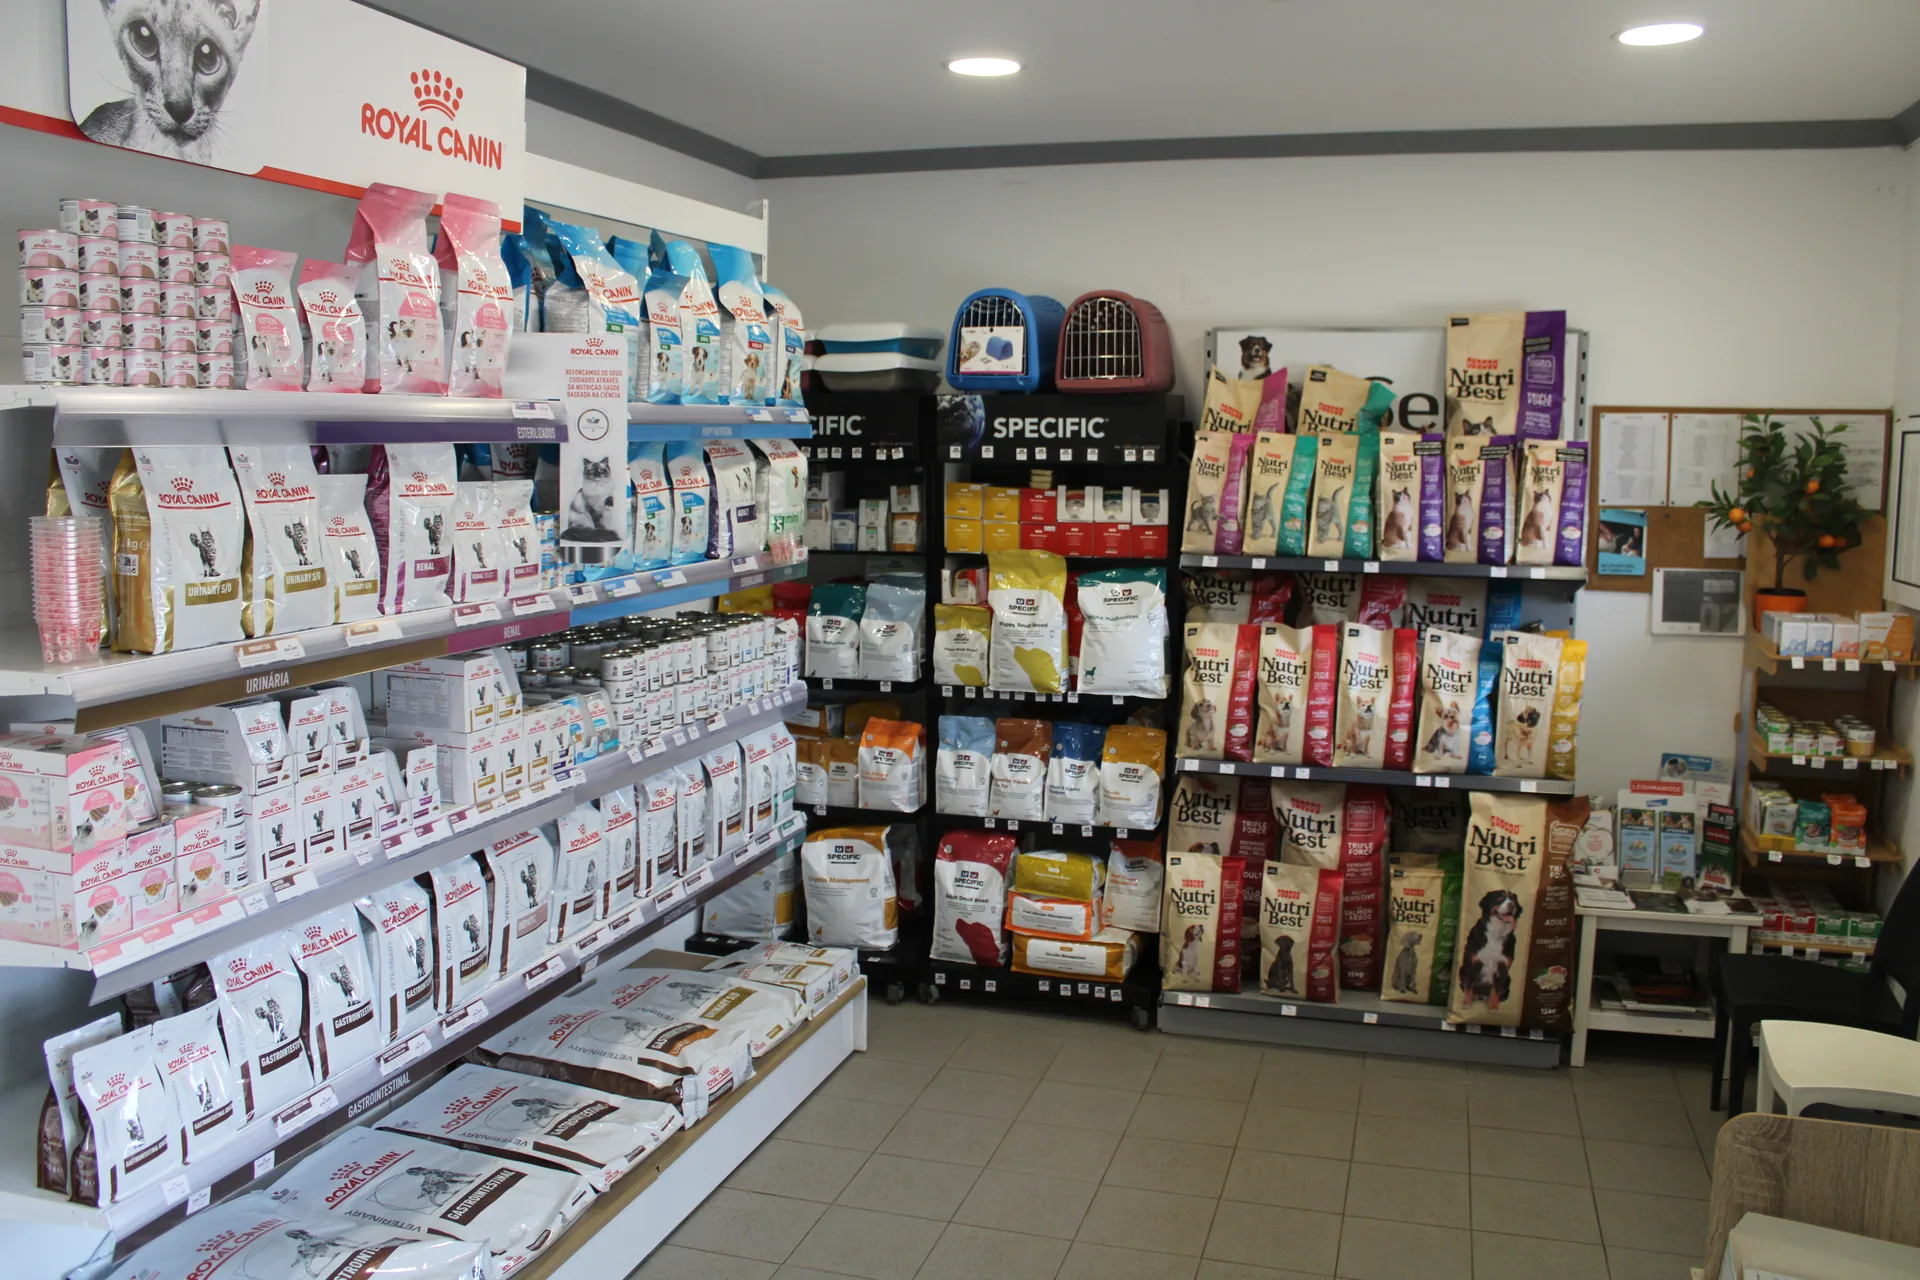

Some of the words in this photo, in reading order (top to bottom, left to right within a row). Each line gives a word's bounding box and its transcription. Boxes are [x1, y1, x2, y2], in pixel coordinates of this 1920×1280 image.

[362, 102, 434, 151] ROYAL
[437, 128, 502, 170] CANIN
[263, 295, 285, 305] CANIN
[603, 286, 632, 299] CANIN
[258, 317, 277, 326] KITTEN
[1450, 368, 1515, 388] Nutri
[1456, 384, 1507, 400] Best
[1527, 392, 1553, 400] TRIPLE
[993, 417, 1105, 438] SPECIFIC
[1204, 408, 1252, 433] Nutri
[1302, 409, 1356, 433] Nutri
[517, 426, 555, 439] ESTERILIZADOS
[1196, 458, 1225, 472] Nutri
[1257, 457, 1288, 469] Nutri
[1260, 465, 1284, 476] Best
[1321, 459, 1352, 473] Nutri
[1385, 461, 1418, 472] Nutri
[1450, 465, 1481, 476] Nutri
[1198, 467, 1221, 479] Best
[1323, 467, 1348, 479] Best
[1389, 470, 1414, 480] Best
[1453, 472, 1477, 483] Best
[1531, 466, 1560, 476] Nutri
[256, 488, 279, 499] ROYAL
[281, 485, 310, 498] CANIN
[405, 483, 425, 493] ROYAL
[426, 483, 447, 493] CANIN
[159, 493, 184, 505] ROYAL
[186, 493, 220, 504] CANIN
[738, 508, 749, 516] ADULT
[416, 562, 435, 571] RENAL
[286, 574, 311, 584] URINARY
[188, 585, 220, 597] URINARY
[1103, 595, 1139, 603] SPECIFIC
[1008, 604, 1039, 612] SPECIFIC
[1409, 603, 1477, 628] Nutri
[504, 627, 521, 638] RENAL
[1262, 657, 1307, 675] Nutri
[1344, 659, 1388, 679] Nutri
[1427, 664, 1472, 683] Nutri
[246, 671, 289, 694] URINÁRIA
[1267, 670, 1301, 686] Best
[1348, 675, 1382, 689] Best
[1504, 667, 1553, 685] Nutri
[1432, 677, 1466, 693] Best
[1508, 682, 1545, 697] Best
[76, 781, 96, 791] ROYAL
[99, 772, 119, 784] CANIN
[91, 792, 108, 801] KITTEN
[1174, 788, 1232, 811] Nutri
[1177, 806, 1222, 825] Best
[1276, 807, 1336, 834] Nutri
[1242, 820, 1267, 828] TRIPLE
[1242, 826, 1267, 834] FORCE
[183, 843, 201, 852] ROYAL
[202, 836, 220, 847] CANIN
[1348, 842, 1374, 850] TRIPLE
[1469, 825, 1537, 855] Nutri
[134, 859, 153, 869] ROYAL
[154, 852, 171, 864] CANIN
[1475, 846, 1528, 871] Best
[80, 876, 101, 887] ROYAL
[102, 867, 123, 880] CANIN
[954, 878, 984, 886] SPECIFIC
[94, 888, 112, 898] KITTEN
[1170, 888, 1215, 905] Nutri
[1177, 901, 1210, 916] Best
[1264, 897, 1310, 917] Nutri
[1392, 897, 1435, 914] Nutri
[1267, 911, 1303, 927] Best
[1394, 910, 1429, 925] Best
[1545, 918, 1567, 927] ADULT
[244, 962, 273, 979] CANIN
[704, 999, 727, 1018] URINARY
[548, 1019, 573, 1041] ROYAL
[567, 1045, 633, 1061] VETERINARY
[348, 1072, 410, 1119] GASTROINTESTINAL
[441, 1109, 474, 1130] ROYAL
[474, 1086, 505, 1110] CANIN
[551, 1103, 608, 1136] GASTROINTESTINAL
[460, 1132, 527, 1147] VETERINARY
[325, 1172, 360, 1204] ROYAL
[361, 1150, 401, 1178] CANIN
[447, 1169, 515, 1221] GASTROINTESTINAL
[344, 1210, 422, 1232] VETERINARY
[186, 1243, 237, 1280] ROYAL
[234, 1218, 283, 1243] CANIN
